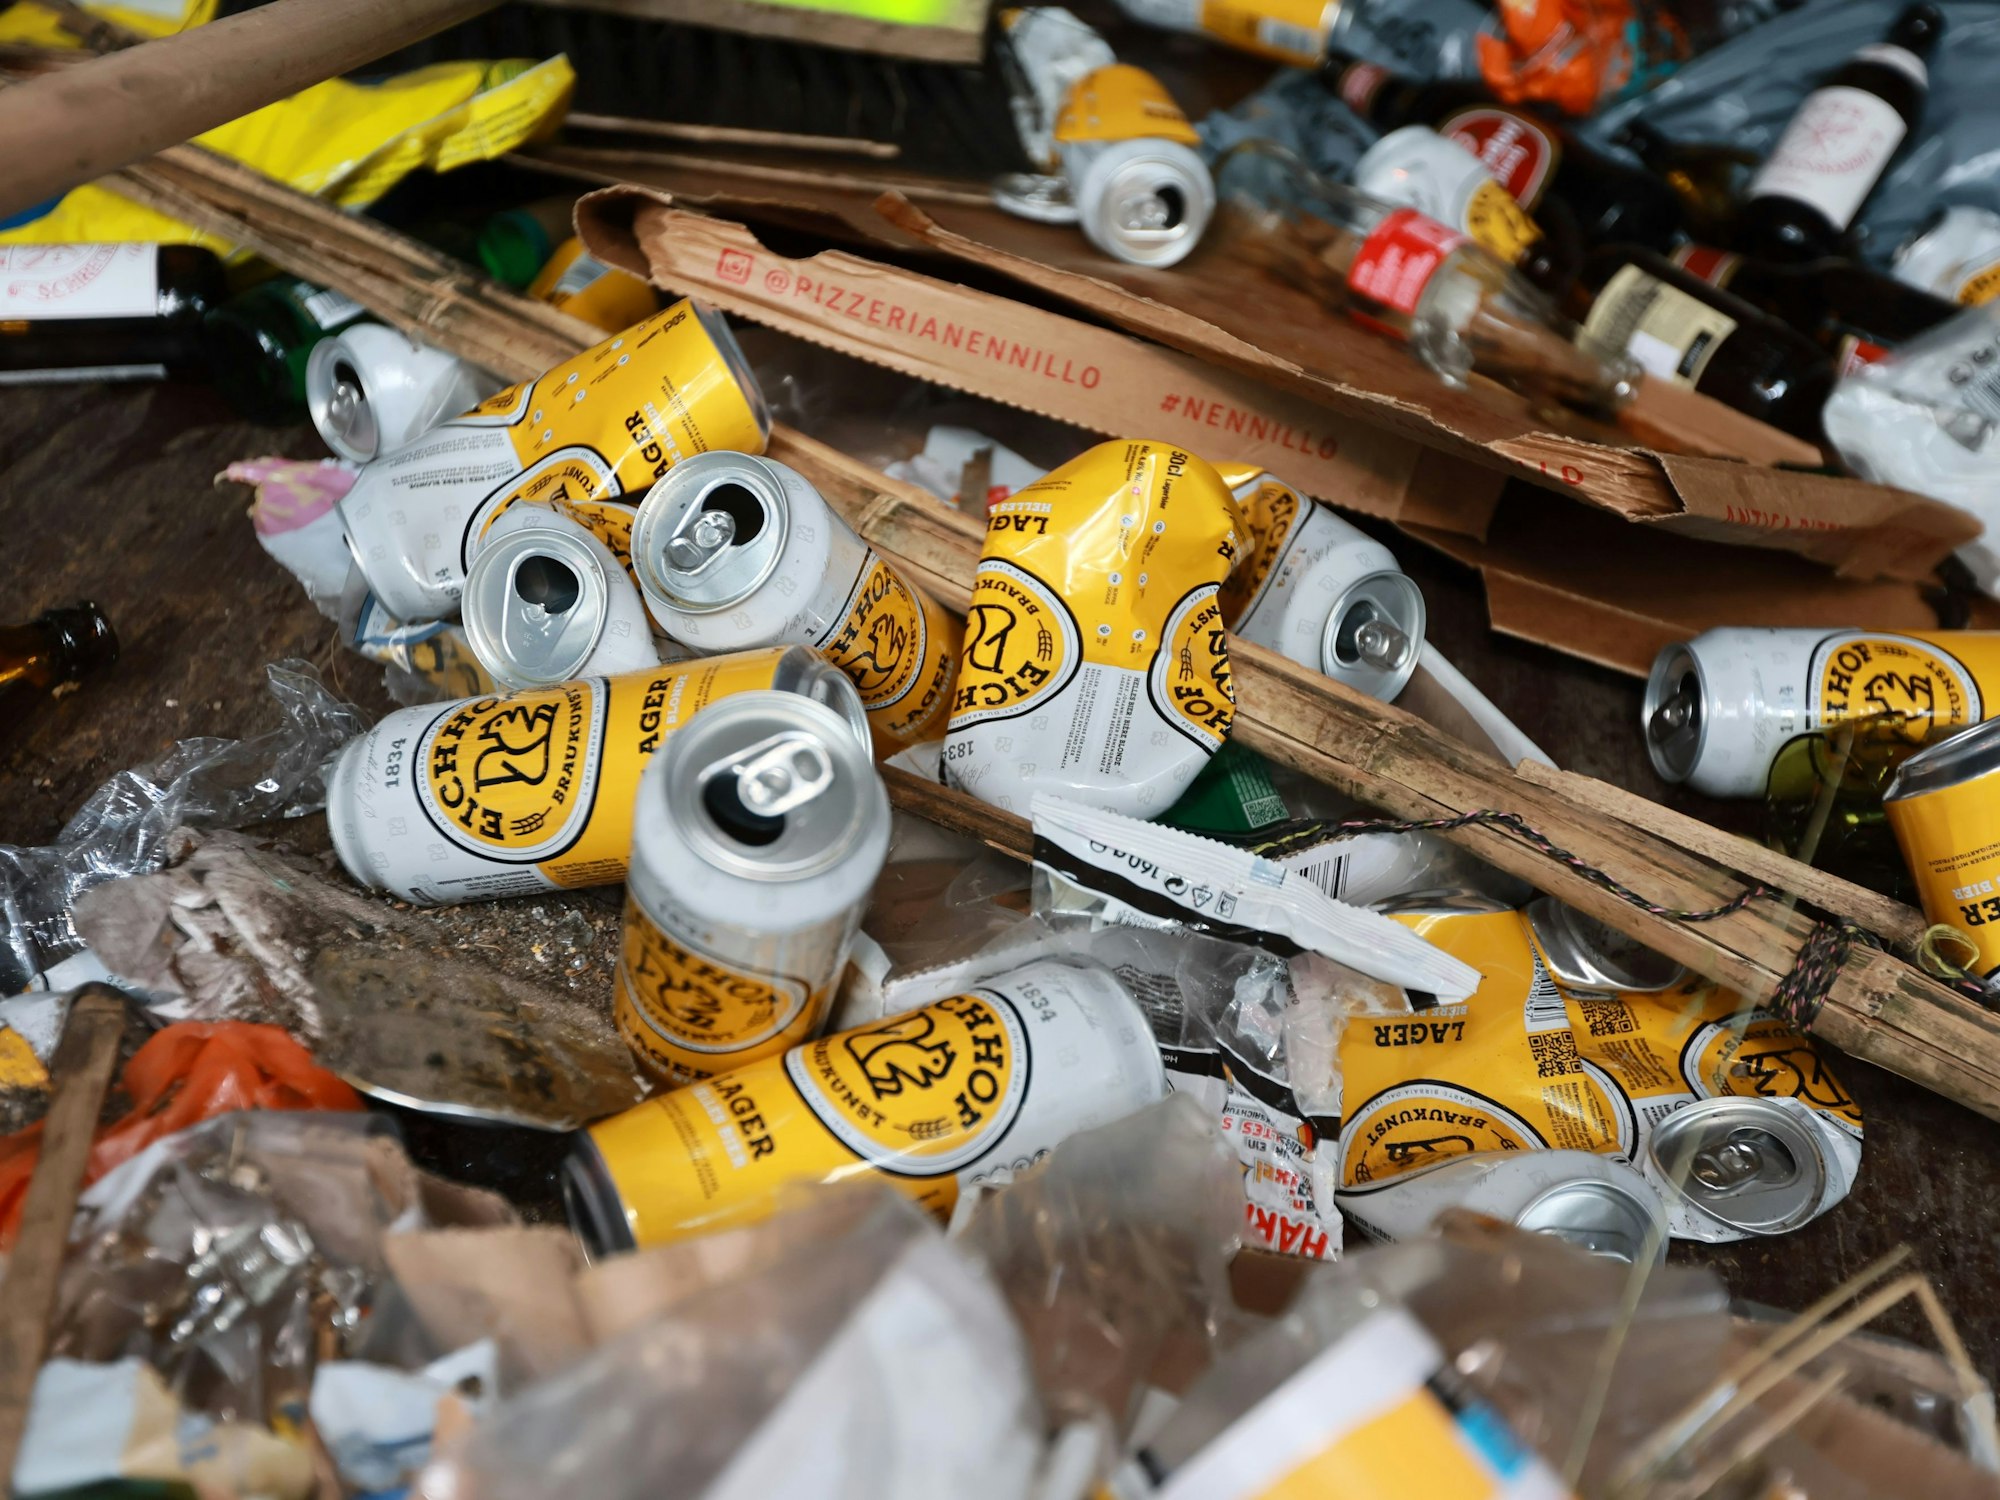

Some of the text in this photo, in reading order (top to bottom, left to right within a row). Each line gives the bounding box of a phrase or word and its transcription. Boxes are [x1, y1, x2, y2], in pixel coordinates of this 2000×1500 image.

[764, 268, 1101, 390] @PIZZERIANENNILLO
[624, 410, 671, 481] AGER
[1160, 393, 1338, 461] #NENNILLO
[1167, 450, 1188, 477] 50cl
[987, 514, 1049, 535] LAG
[1001, 501, 1052, 513] HELLES
[665, 674, 689, 725] BLONDE
[887, 652, 949, 731] LAGER
[953, 660, 1051, 712] EICH
[1117, 673, 1126, 695] LAGERTE
[1925, 660, 1962, 725] KUNST
[639, 677, 672, 755] AGER
[1078, 699, 1087, 719] DARAUS
[1081, 700, 1094, 734] STARTSCHUSS
[1113, 676, 1140, 766] HELLES BIER BIÈRE BLONDE
[552, 689, 584, 805] BRAUKUNST
[1072, 720, 1082, 745] ENTSTAND
[1078, 735, 1086, 745] FÜR
[1104, 720, 1115, 749] BESONDERS
[385, 738, 407, 789] 1834
[1074, 745, 1082, 763] DIESEN
[1953, 879, 1994, 901] BIER
[1016, 981, 1057, 1024] 1834
[1431, 1005, 1468, 1018] BIÈRE
[1374, 1021, 1466, 1047] LAGER
[934, 995, 1005, 1130] CHHOF
[711, 1074, 775, 1162] LAGER
[1367, 1108, 1489, 1147] BRAUKUNST
